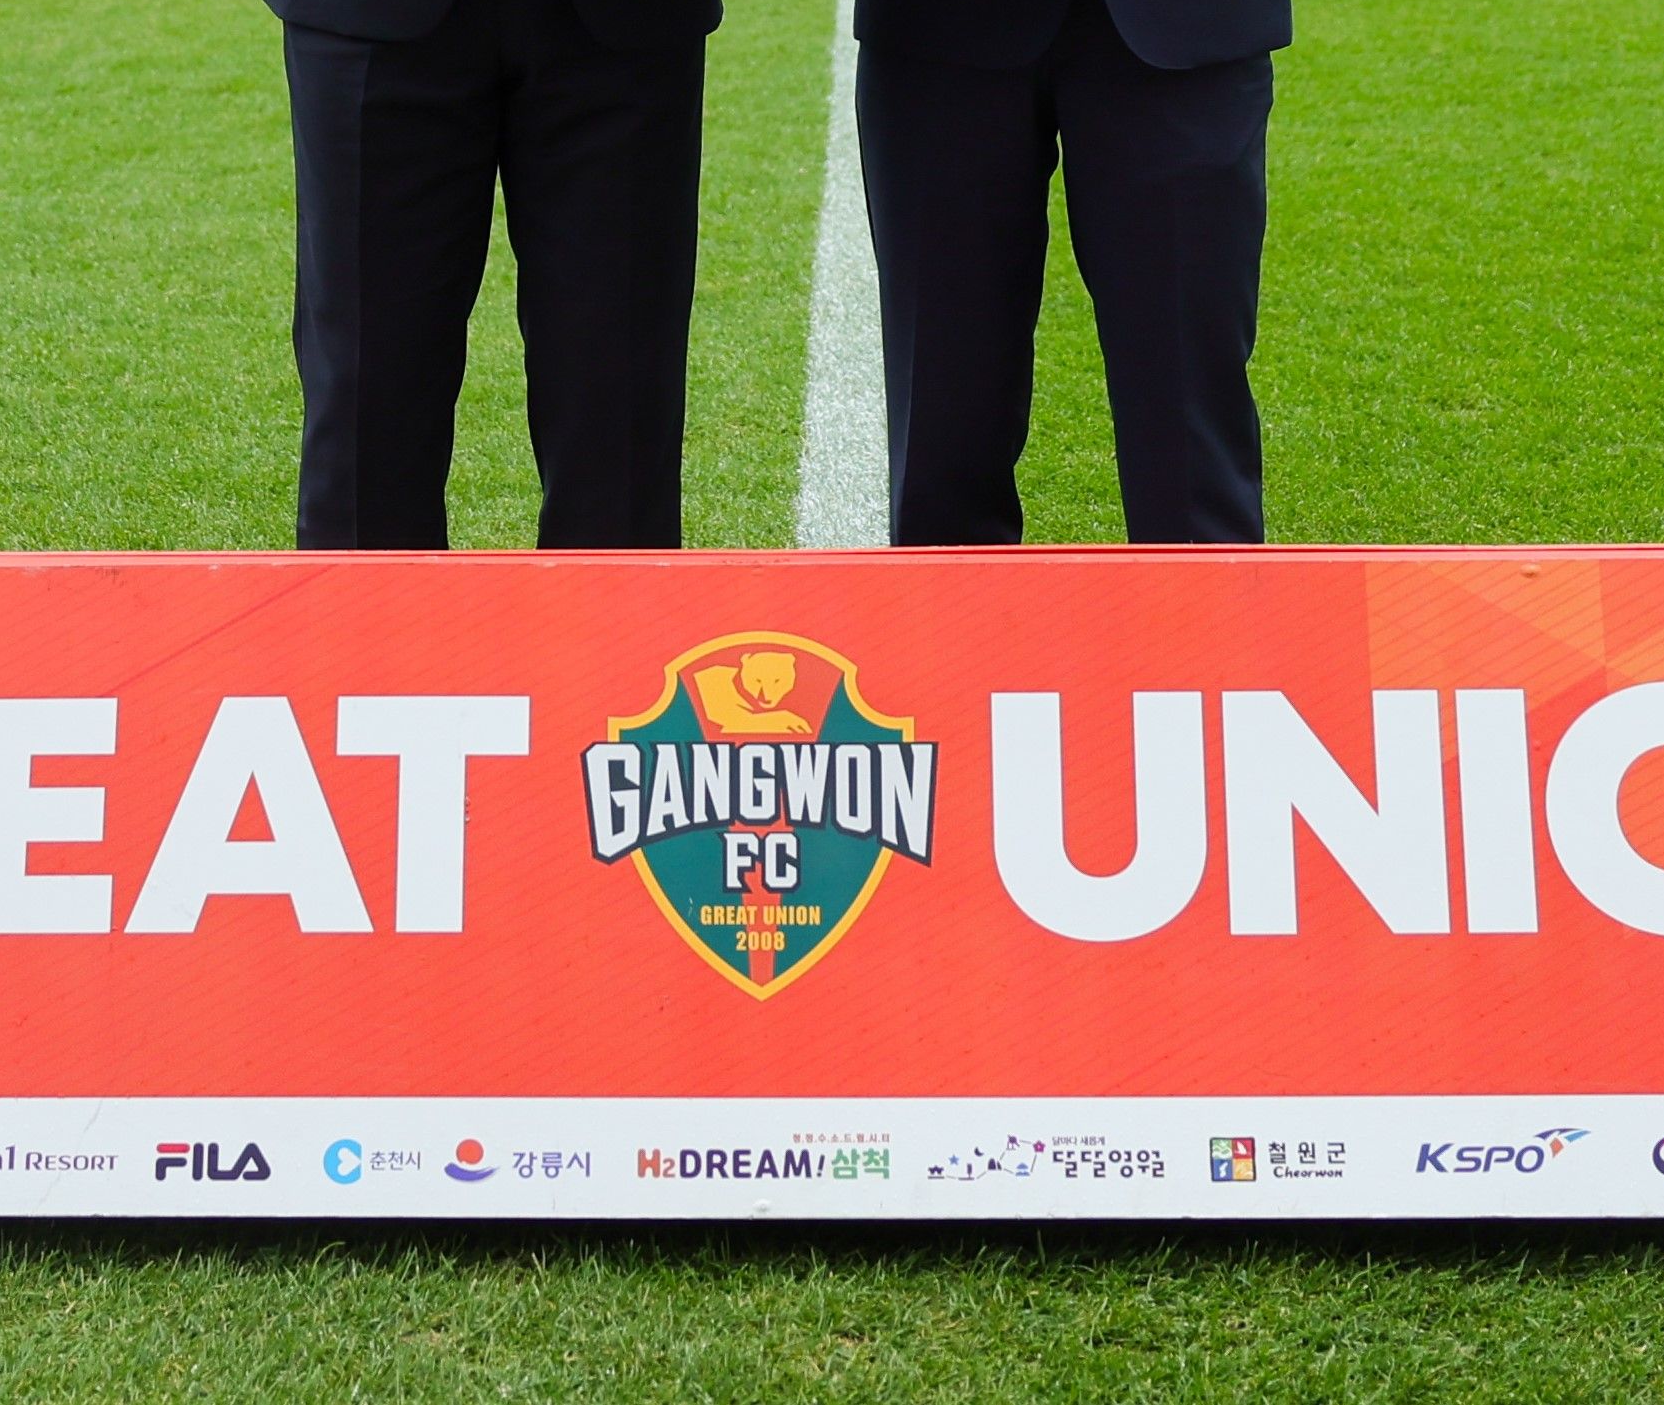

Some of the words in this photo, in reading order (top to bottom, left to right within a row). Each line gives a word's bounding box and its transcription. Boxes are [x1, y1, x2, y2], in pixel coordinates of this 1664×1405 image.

[581, 741, 937, 866] GANGWON
[721, 831, 802, 894] FC
[700, 905, 757, 926] GREAT
[762, 905, 822, 926] UNION
[735, 930, 786, 952] 2008
[25, 1151, 118, 1172] RESORT
[154, 1142, 272, 1182] FILA
[369, 1150, 421, 1171] 춘천시
[512, 1151, 591, 1179] 강릉시
[1052, 1149, 1165, 1179] 달달영월
[1416, 1143, 1545, 1174] KSPO
